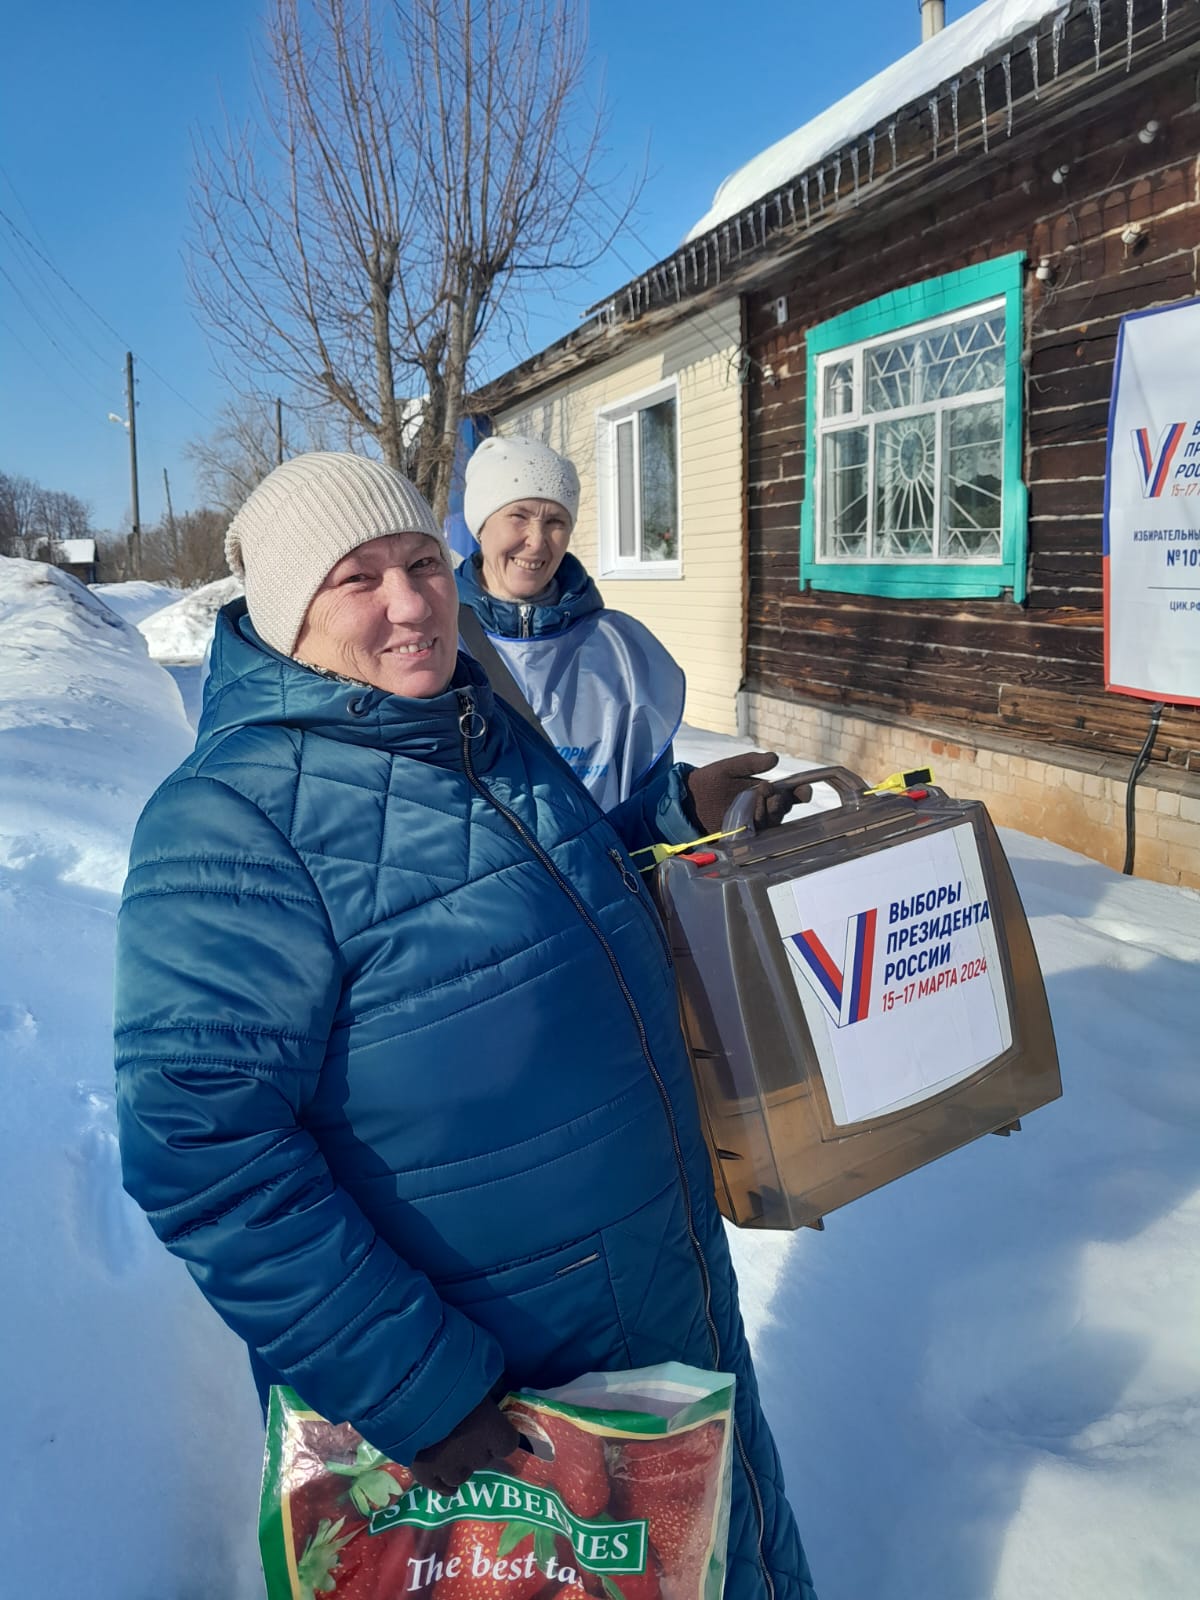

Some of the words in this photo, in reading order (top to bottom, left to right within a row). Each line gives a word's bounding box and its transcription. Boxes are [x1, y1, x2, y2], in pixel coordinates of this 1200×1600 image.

[889, 881, 962, 924] ВЫБОРЫ
[886, 900, 990, 955] ПРЕЗИДЕНТА
[884, 942, 951, 986] РОССИИ
[918, 971, 958, 999] МАРТА
[960, 956, 987, 983] 2024
[407, 1552, 461, 1592] The
[472, 1544, 538, 1584] best
